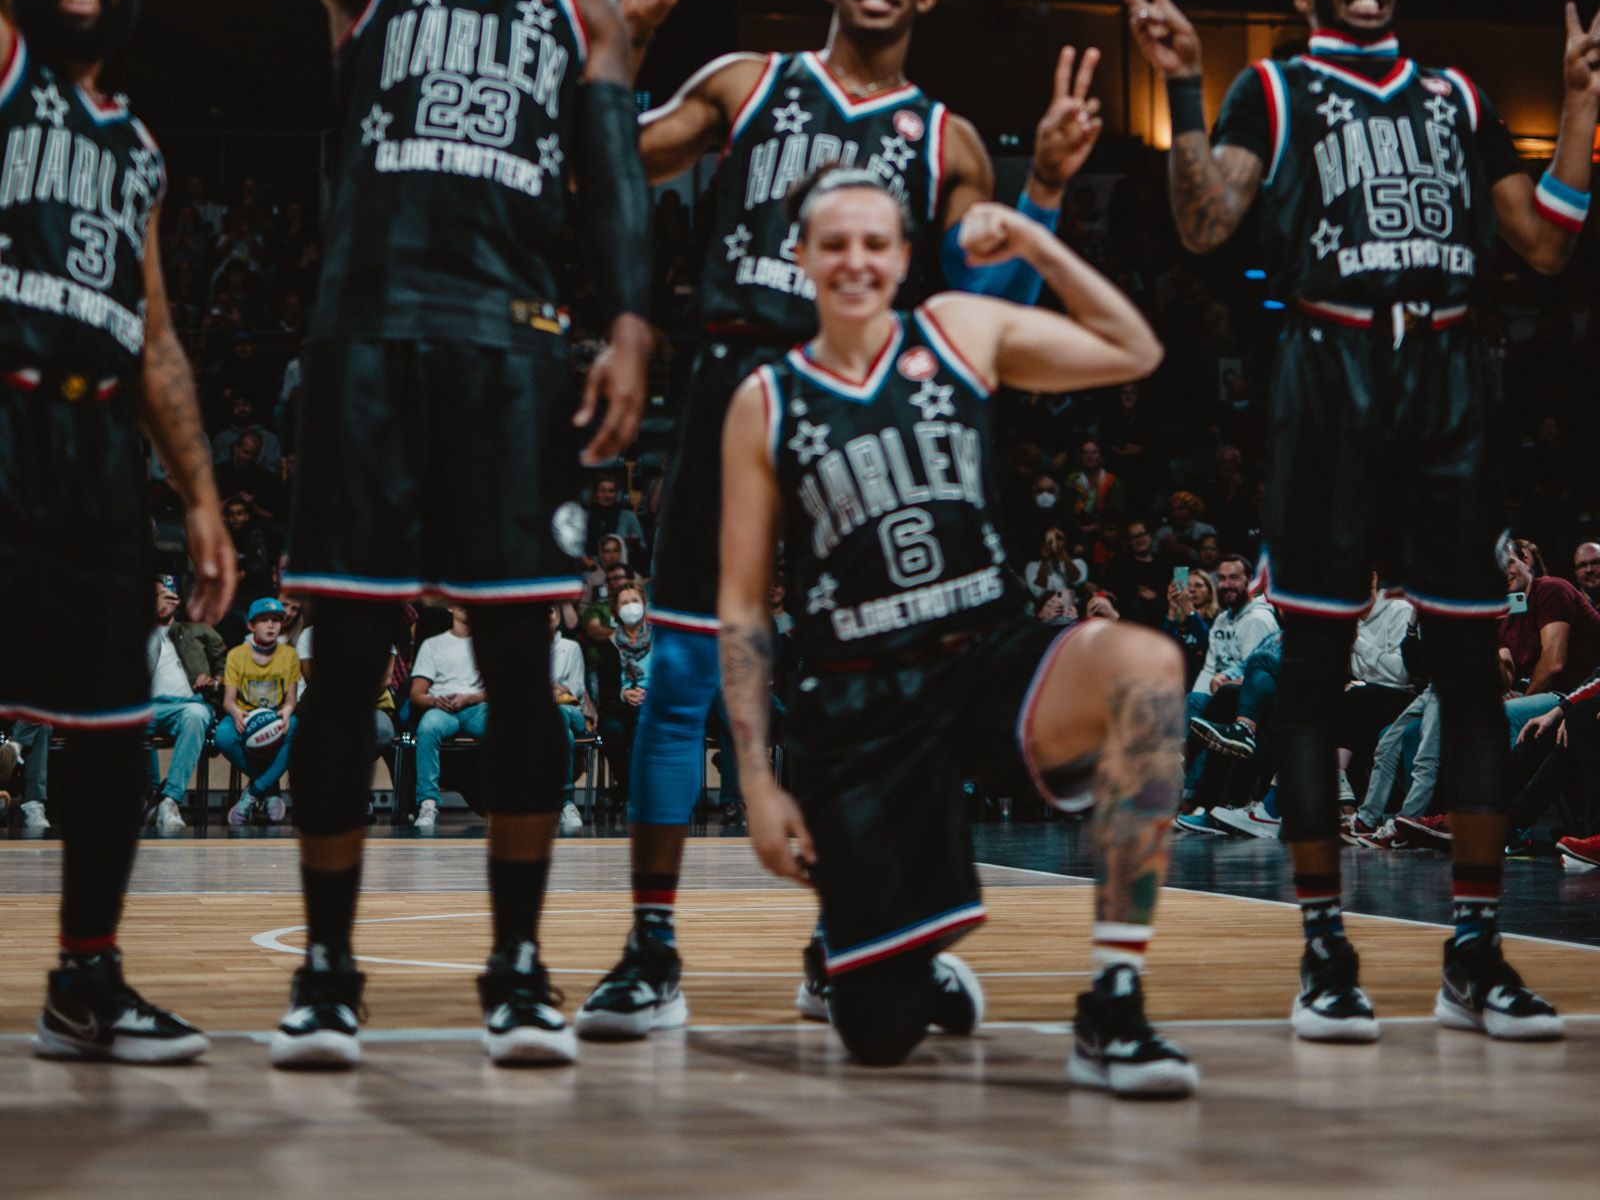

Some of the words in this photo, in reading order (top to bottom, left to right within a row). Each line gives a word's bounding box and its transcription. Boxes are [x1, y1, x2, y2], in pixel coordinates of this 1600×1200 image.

[380, 5, 569, 120] HARLEM
[415, 69, 521, 149] 23
[0, 123, 153, 264] HARLE
[1362, 176, 1453, 239] 56
[66, 211, 118, 290] 3
[877, 506, 945, 589] 6
